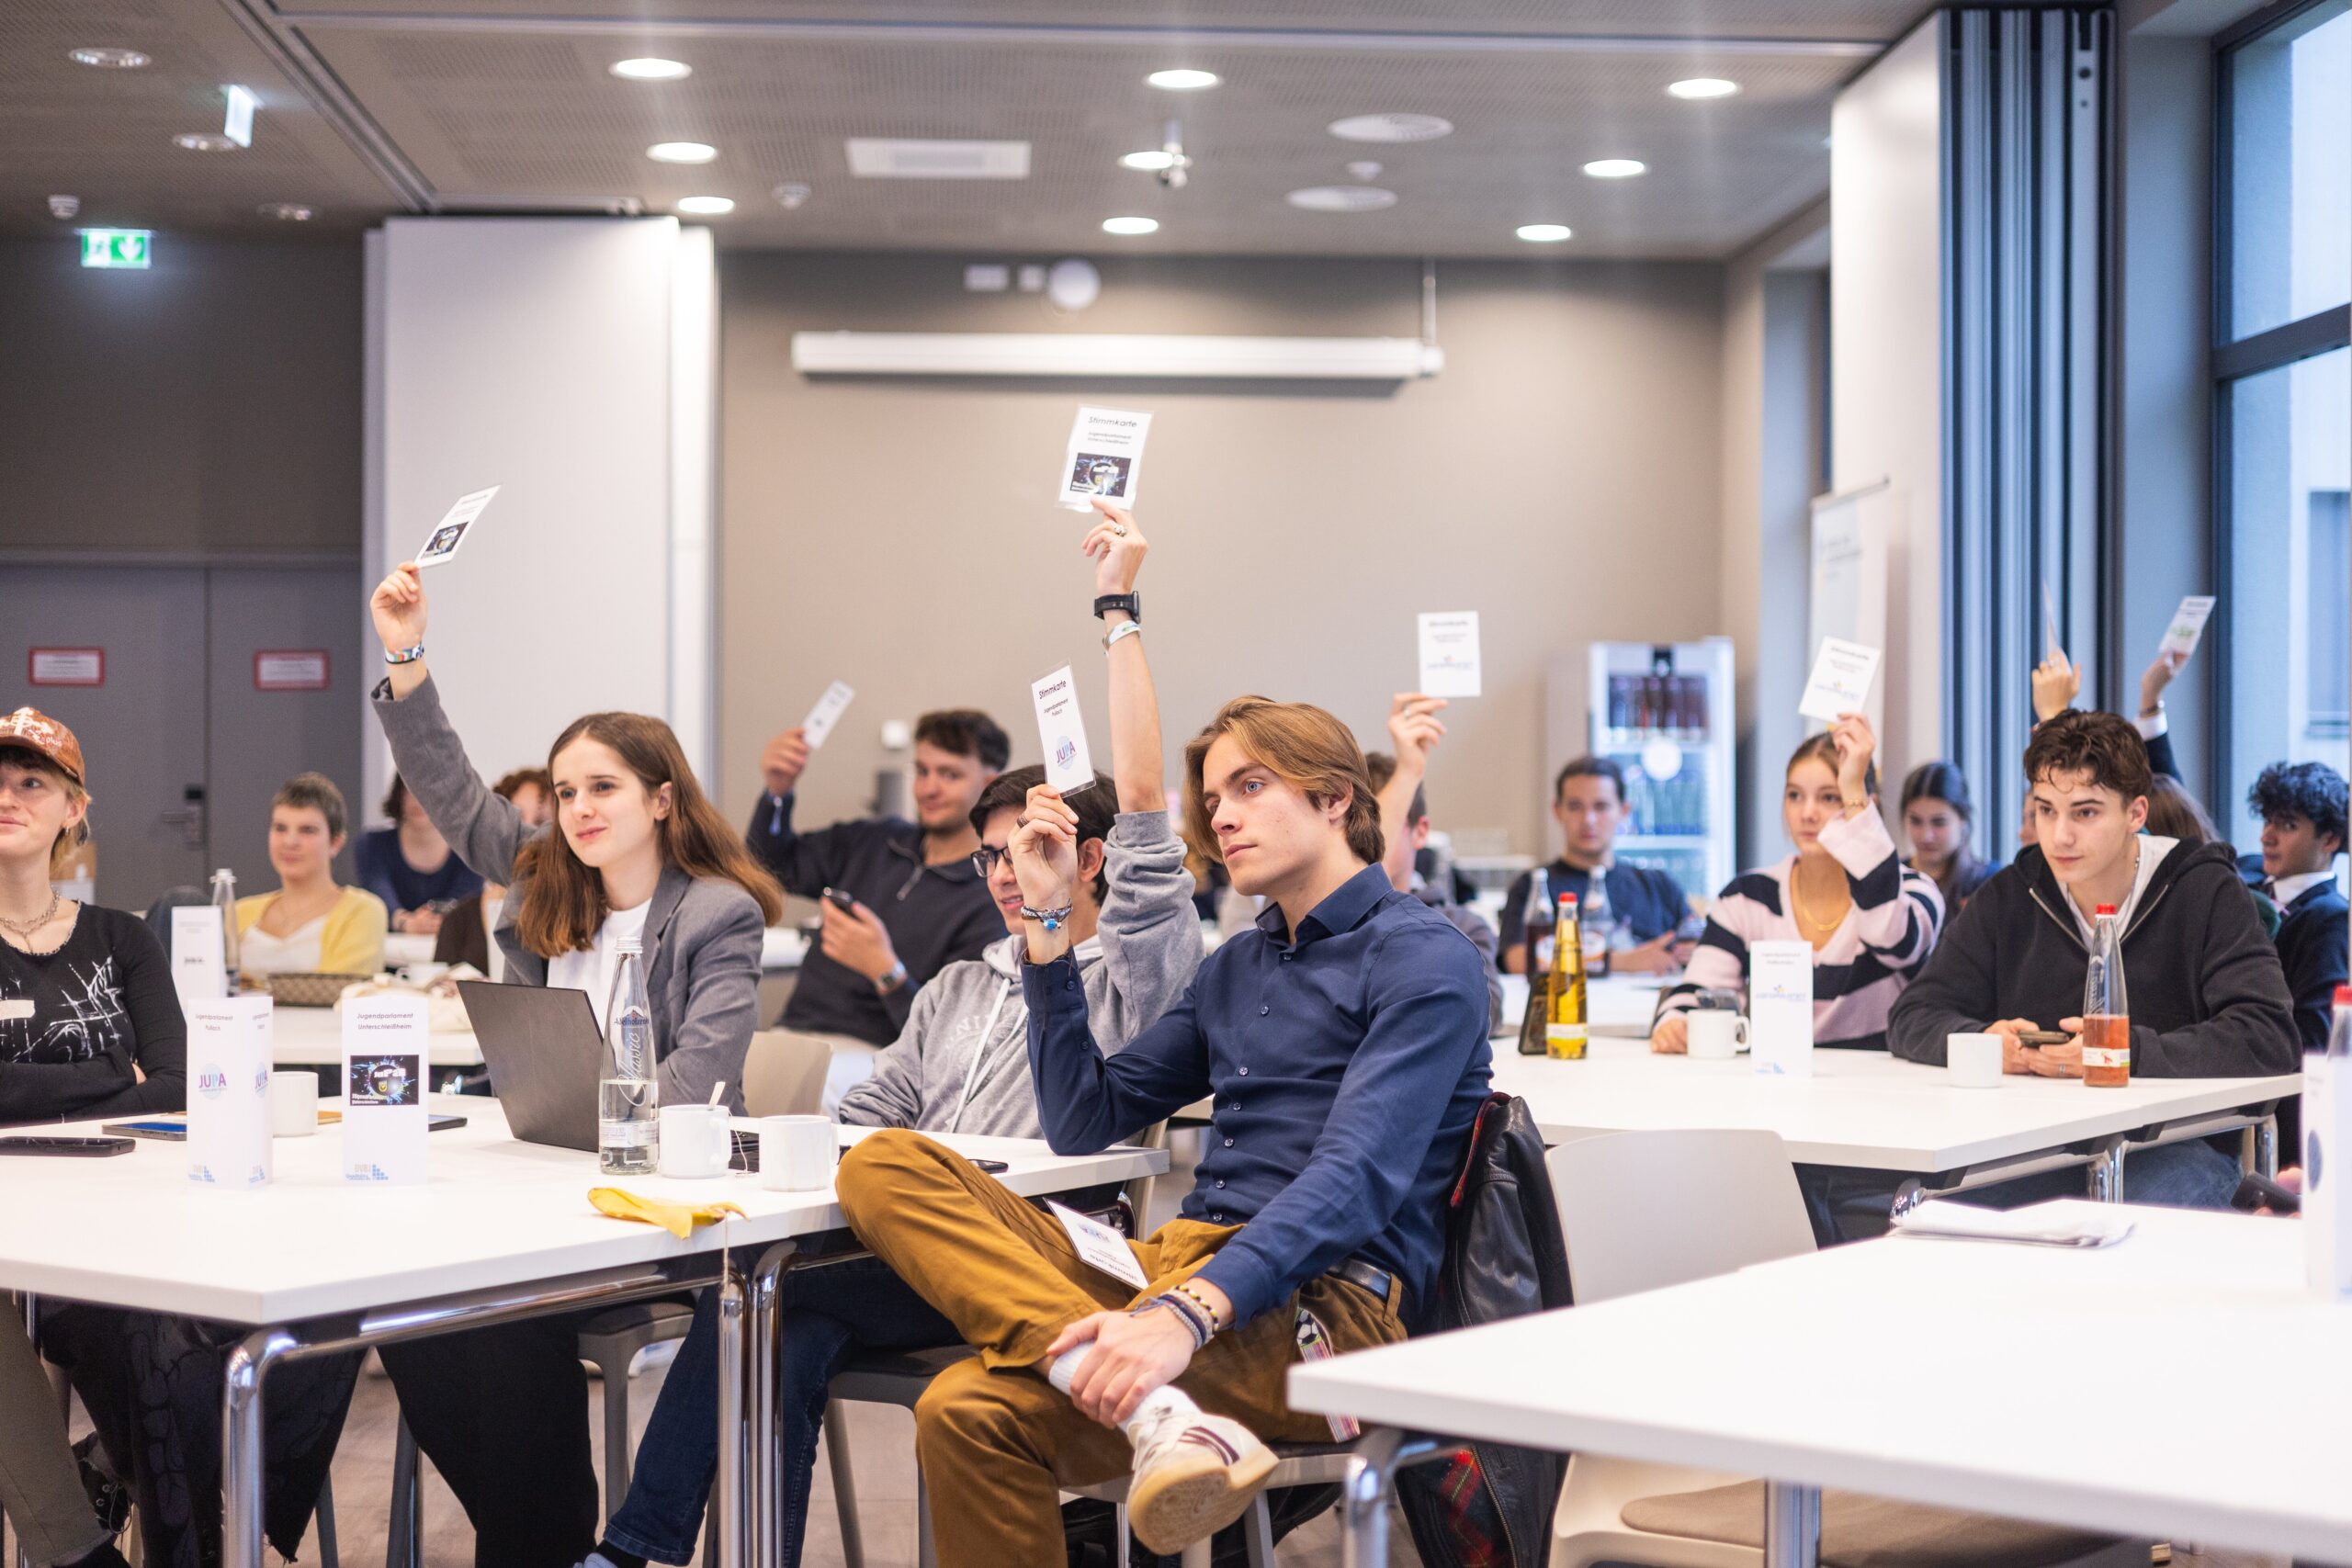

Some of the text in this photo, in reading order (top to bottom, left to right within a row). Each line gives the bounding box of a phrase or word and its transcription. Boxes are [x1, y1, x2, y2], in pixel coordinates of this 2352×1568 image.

[1088, 416, 1137, 428] Stimmkarte
[1038, 680, 1067, 700] Stimmkarte
[1057, 740, 1076, 763] JUPA
[198, 1072, 227, 1089] JUPA
